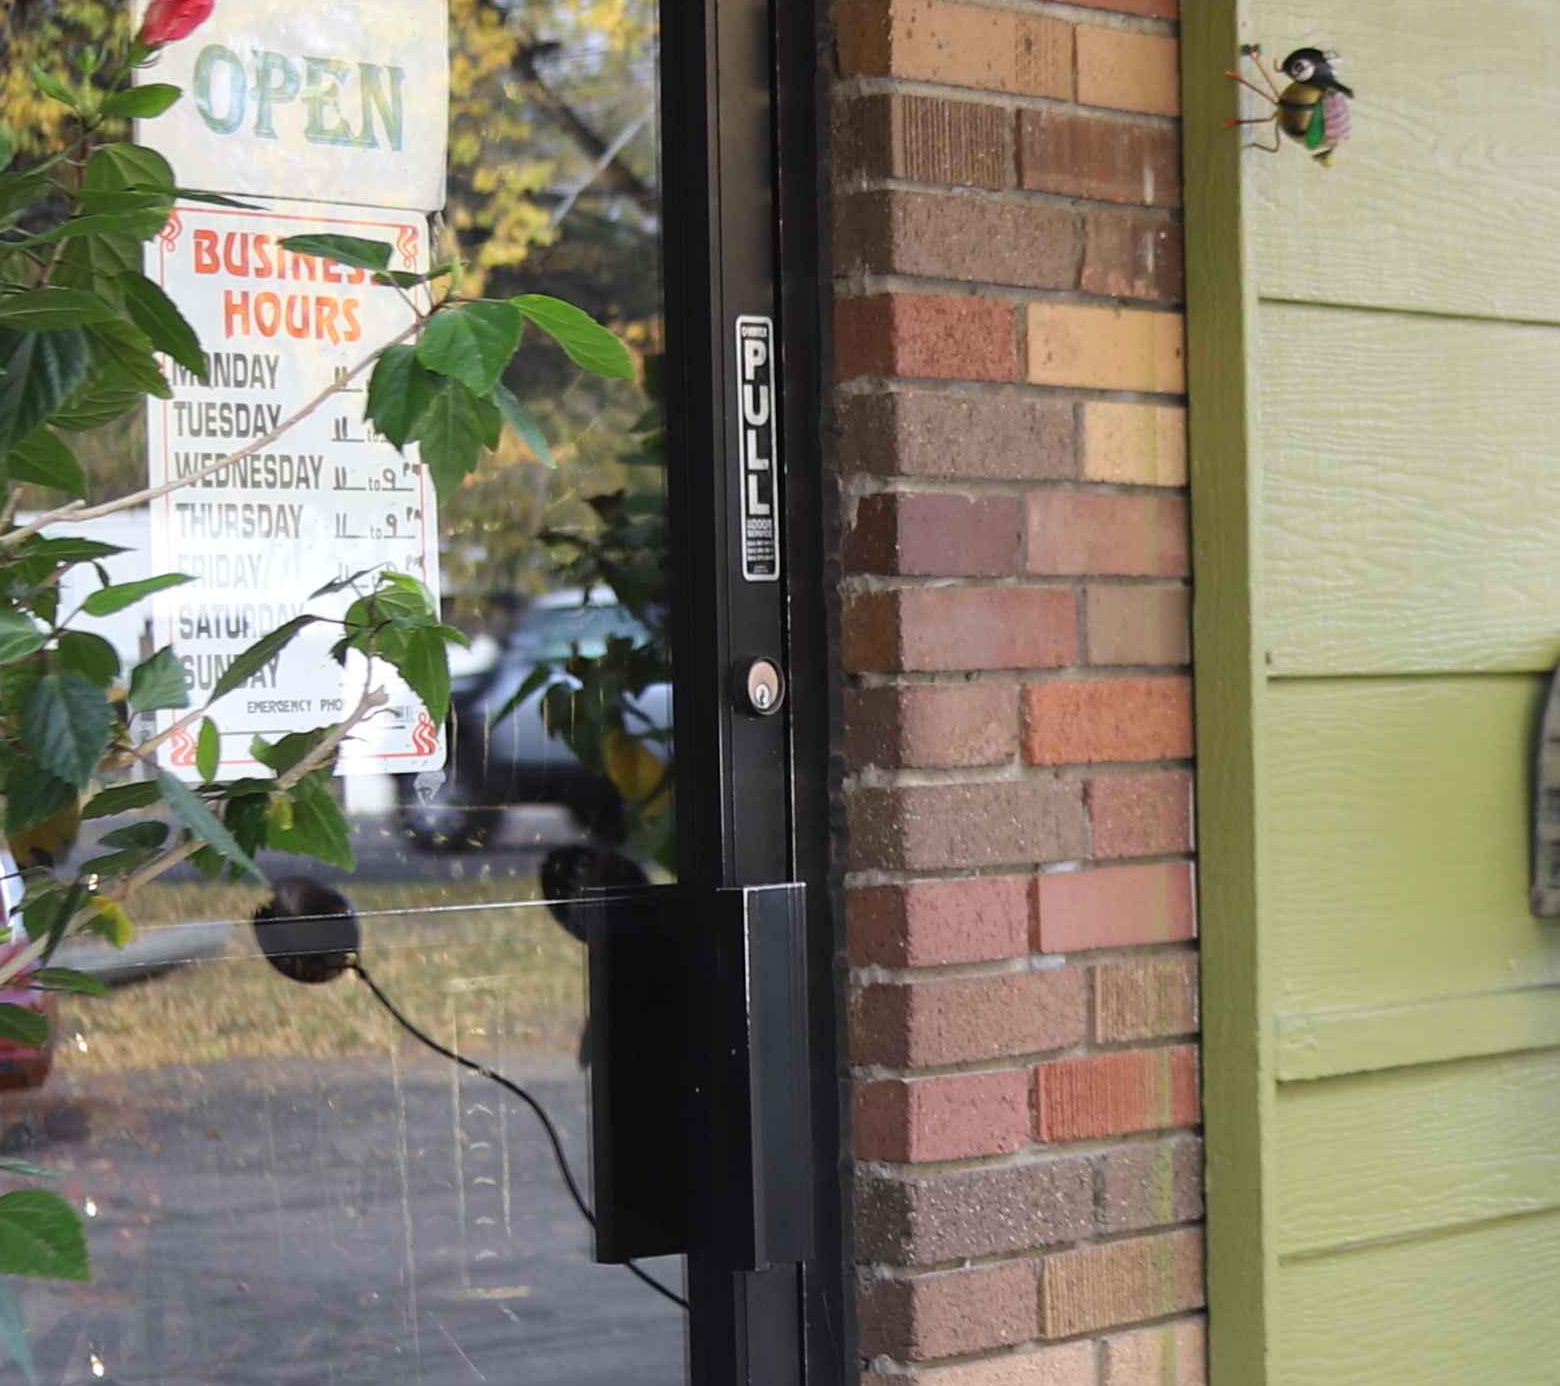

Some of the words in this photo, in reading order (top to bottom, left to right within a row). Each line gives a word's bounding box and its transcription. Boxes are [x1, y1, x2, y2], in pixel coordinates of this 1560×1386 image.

[193, 44, 408, 152] OPEN
[193, 229, 382, 286] BUSINE
[223, 289, 362, 346] HOURS
[173, 401, 282, 438] TUESDAY
[742, 339, 771, 515] PULL
[174, 452, 324, 490] WEDNESDAY
[368, 476, 381, 492] to
[382, 467, 397, 491] 9
[175, 502, 304, 539] THURSDAY
[369, 525, 383, 541] to
[385, 513, 398, 538] 9
[177, 553, 263, 589] FRIDAY
[179, 602, 305, 640] SATURDAY
[180, 653, 281, 692] SUNAY
[246, 699, 312, 714] EMERGENCY
